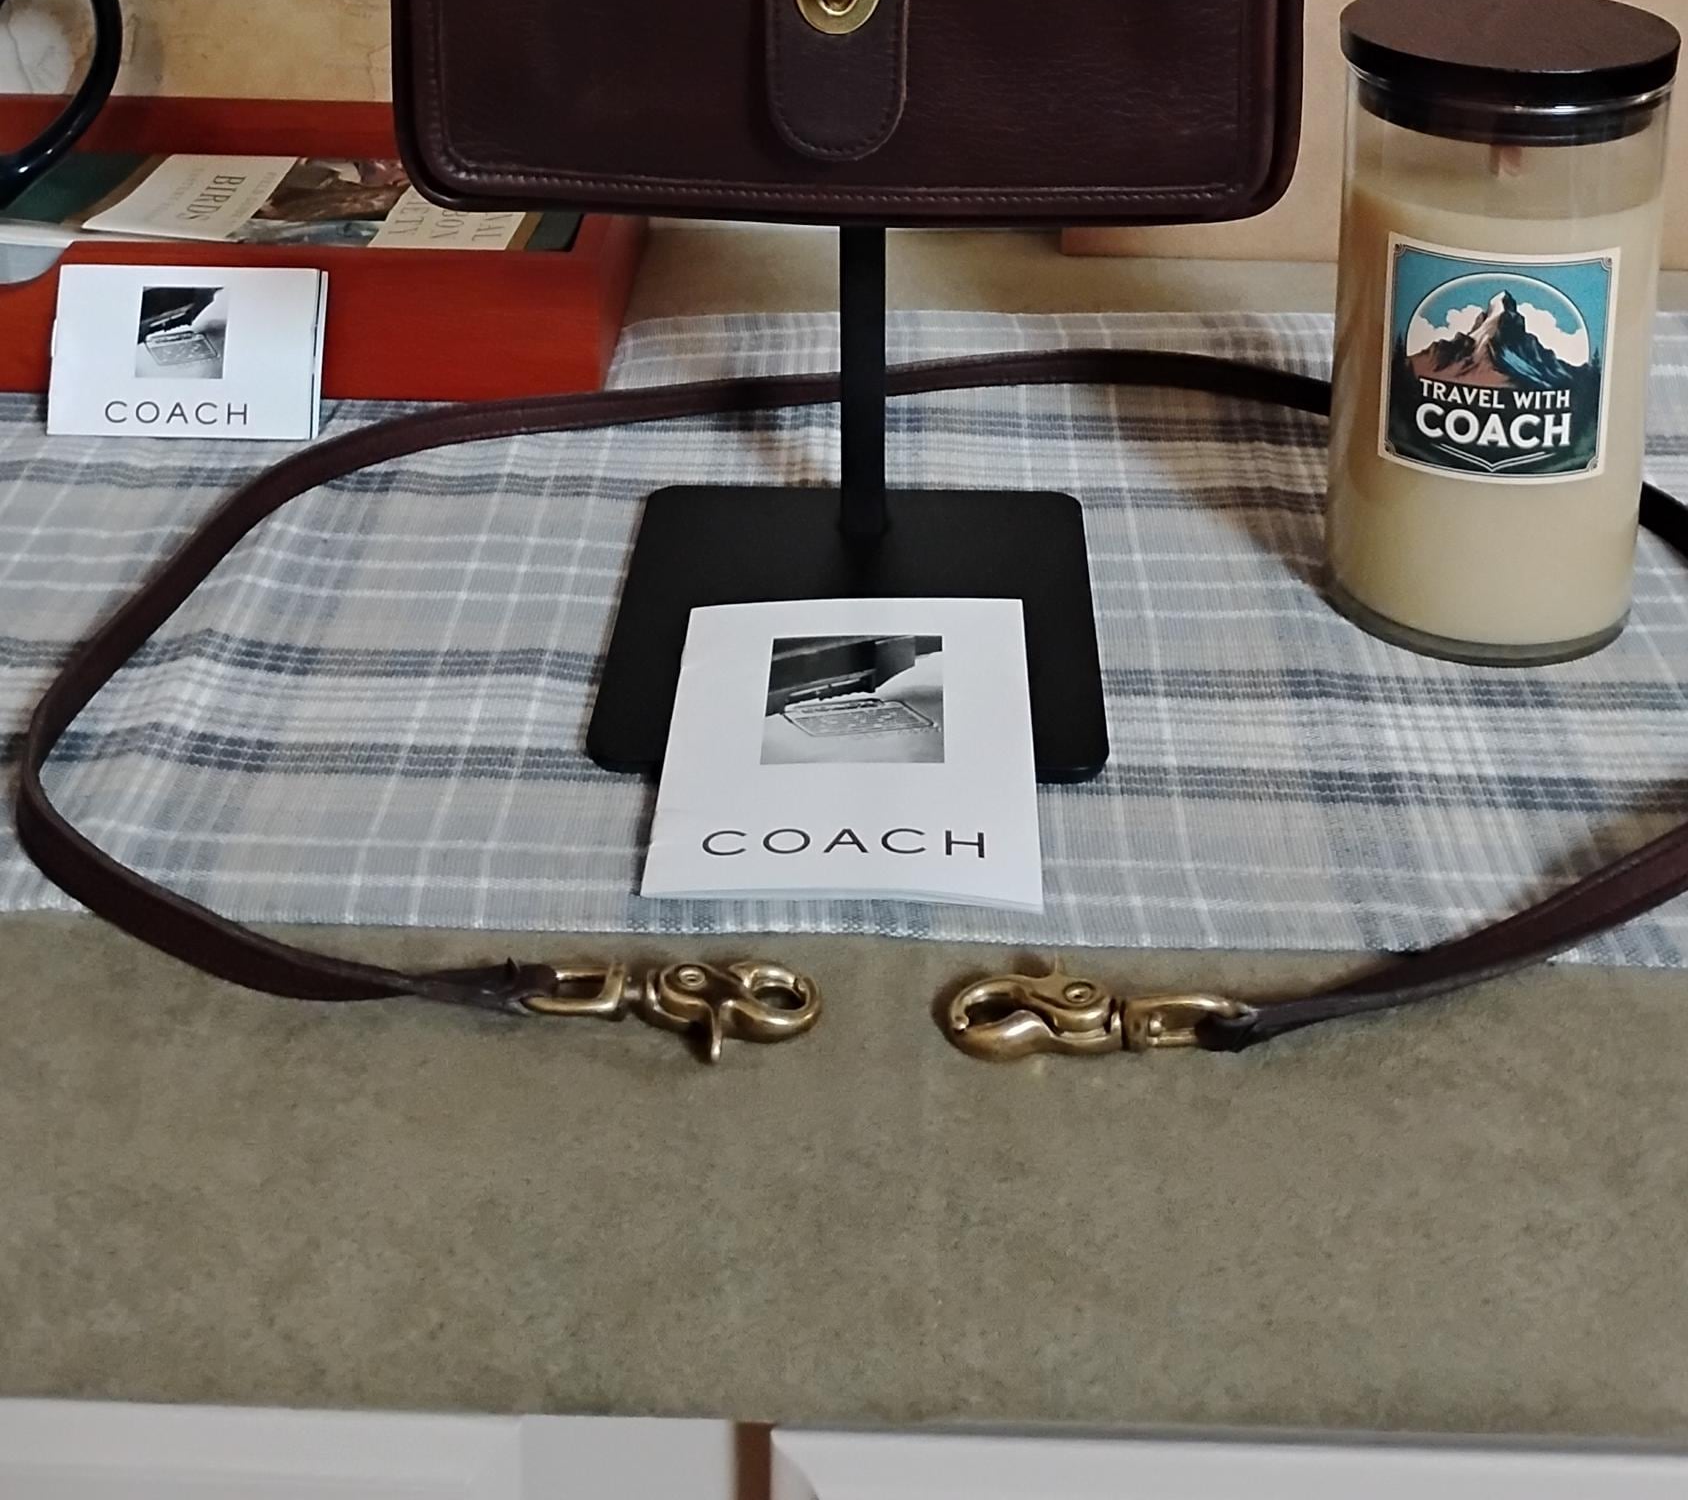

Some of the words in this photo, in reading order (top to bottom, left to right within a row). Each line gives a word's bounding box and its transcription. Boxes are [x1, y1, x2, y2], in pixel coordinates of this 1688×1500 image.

[176, 175, 247, 220] BIRDS
[1419, 377, 1505, 409] TRAVEL
[1512, 388, 1571, 411] WITH
[104, 400, 248, 425] COACH
[1415, 402, 1571, 449] COACH
[702, 827, 986, 859] COACH
